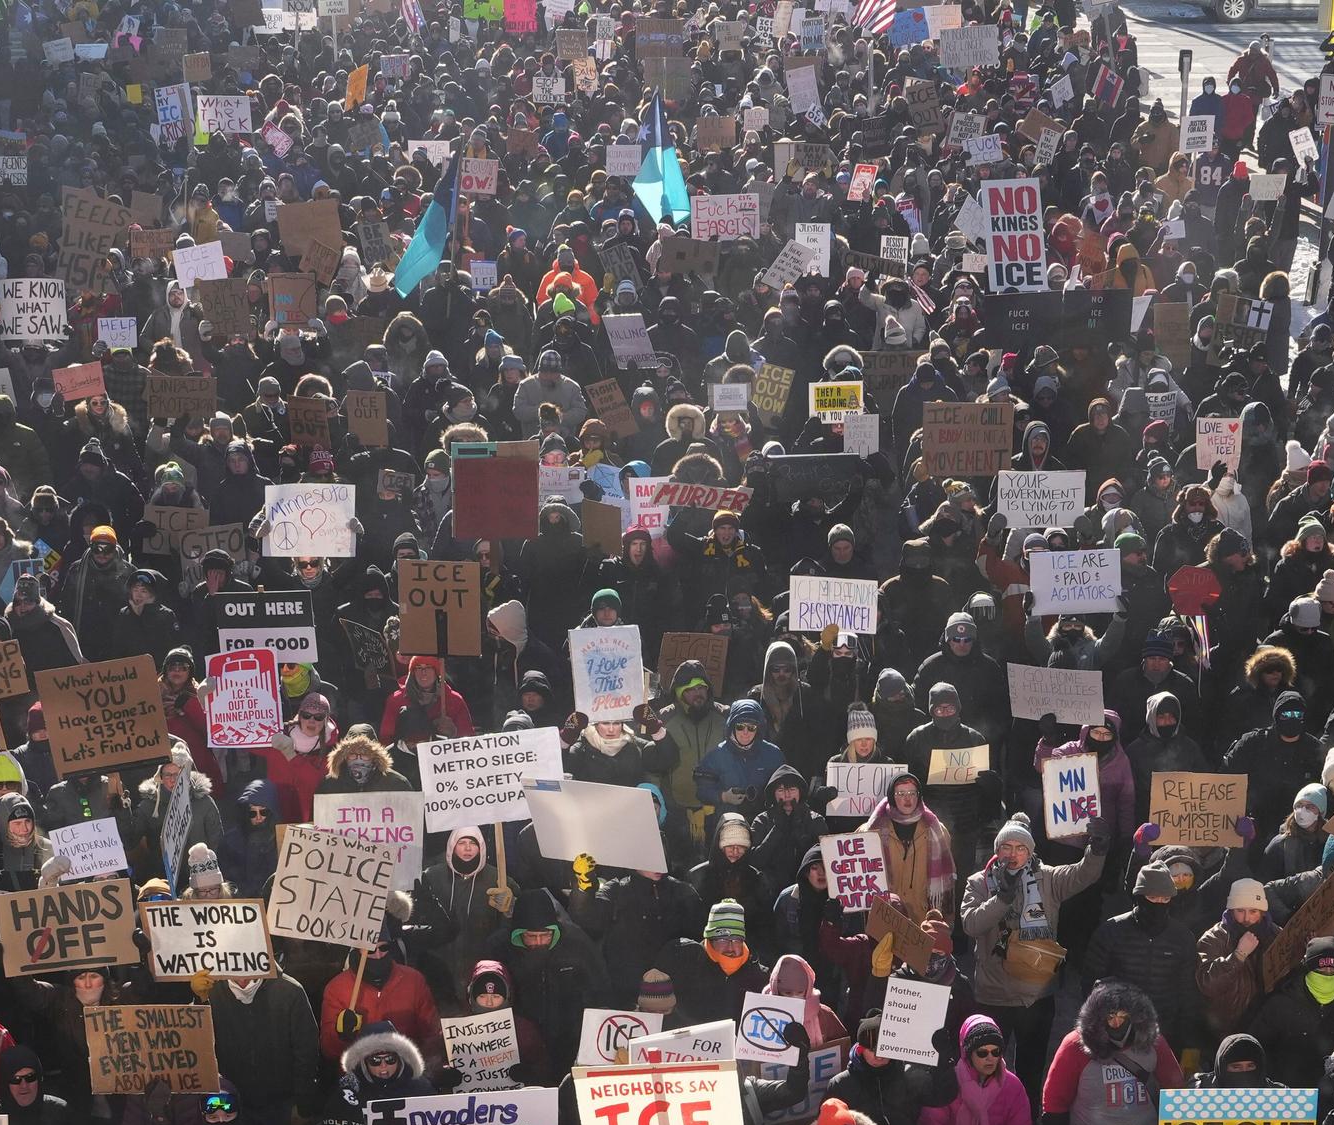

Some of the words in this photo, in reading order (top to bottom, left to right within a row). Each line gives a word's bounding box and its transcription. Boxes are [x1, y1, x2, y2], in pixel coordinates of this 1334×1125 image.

[536, 79, 558, 87] STOP
[208, 119, 249, 130] FUCK
[1187, 119, 1207, 128] JUSTICE
[1200, 167, 1222, 184] 84
[988, 187, 1038, 215] NO
[991, 216, 1038, 230] KINGS
[993, 234, 1040, 262] NO
[995, 263, 1042, 287] ICE
[3, 282, 24, 300] WE
[29, 280, 66, 299] KNOW
[17, 302, 51, 313] WHAT
[1, 315, 27, 336] WE
[30, 315, 62, 335] SAW
[761, 366, 794, 383] ICE
[757, 381, 791, 398] OUT
[816, 388, 835, 397] THEY
[754, 396, 786, 413] NOW
[816, 398, 847, 409] TREADING
[1198, 422, 1225, 437] LOVE
[654, 484, 749, 510] MURDER
[1051, 554, 1076, 569] ICE
[1082, 552, 1110, 568] ARE
[1063, 570, 1091, 586] PAID
[1050, 583, 1116, 601] AGITATORS
[225, 602, 255, 616] OUT
[266, 601, 304, 615] HERE
[265, 636, 309, 651] GOOD
[595, 657, 628, 678] Love
[97, 667, 138, 687] Would
[594, 675, 625, 692] This
[77, 684, 126, 709] YOU
[590, 695, 633, 713] Place
[59, 713, 90, 730] Have
[94, 708, 132, 725] Done
[139, 703, 157, 715] In
[85, 719, 135, 744] 1939?
[97, 739, 129, 758] Find
[134, 735, 161, 751] Out
[1163, 779, 1238, 801] RELEASE
[1181, 801, 1207, 812] THE
[1152, 811, 1239, 830] TRUMPSTEIN
[1178, 827, 1220, 843] FILES
[11, 886, 124, 930] HANDS
[147, 907, 185, 927] THE
[190, 907, 257, 926] WORLD
[195, 930, 217, 948] IS
[158, 952, 270, 973] WATCHING
[890, 985, 922, 998] Mother,
[887, 999, 917, 1012] should
[890, 1013, 911, 1024] trust
[882, 1029, 896, 1037] the
[879, 1043, 936, 1057] government?
[591, 1082, 683, 1100] NEIGHBORS
[690, 1080, 717, 1093] SAY
